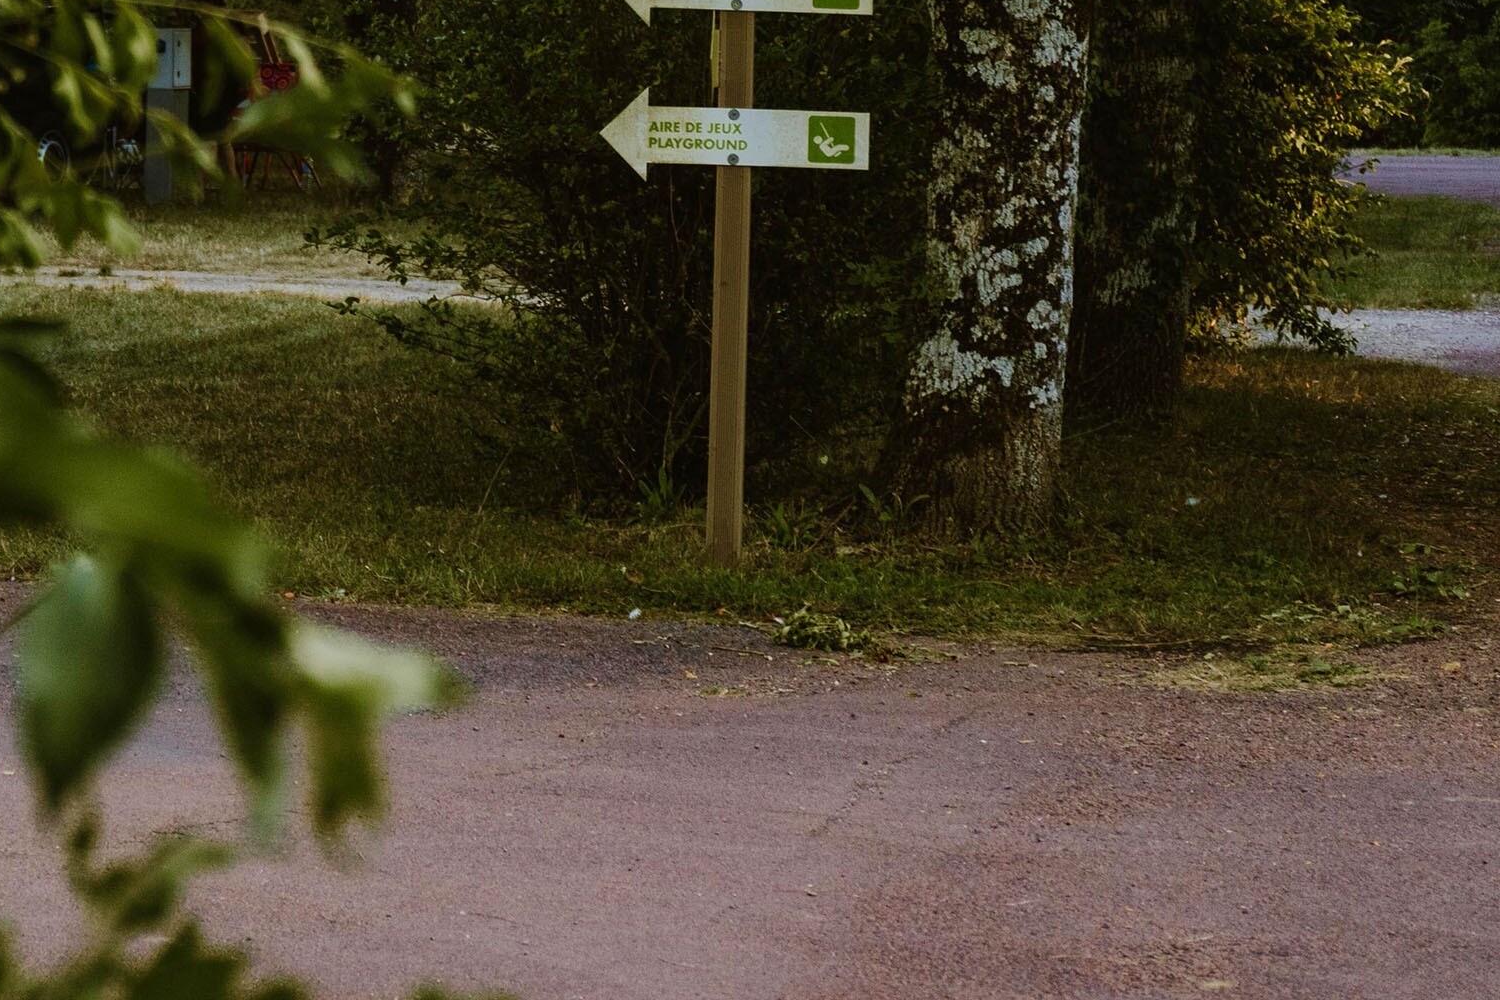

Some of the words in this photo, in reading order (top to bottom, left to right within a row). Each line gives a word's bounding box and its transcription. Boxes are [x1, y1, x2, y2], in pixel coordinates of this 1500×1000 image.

[648, 121, 680, 133] AIRE
[685, 122, 702, 133] DE
[707, 123, 742, 134] JEUX
[648, 137, 748, 151] PLAYGROUND
